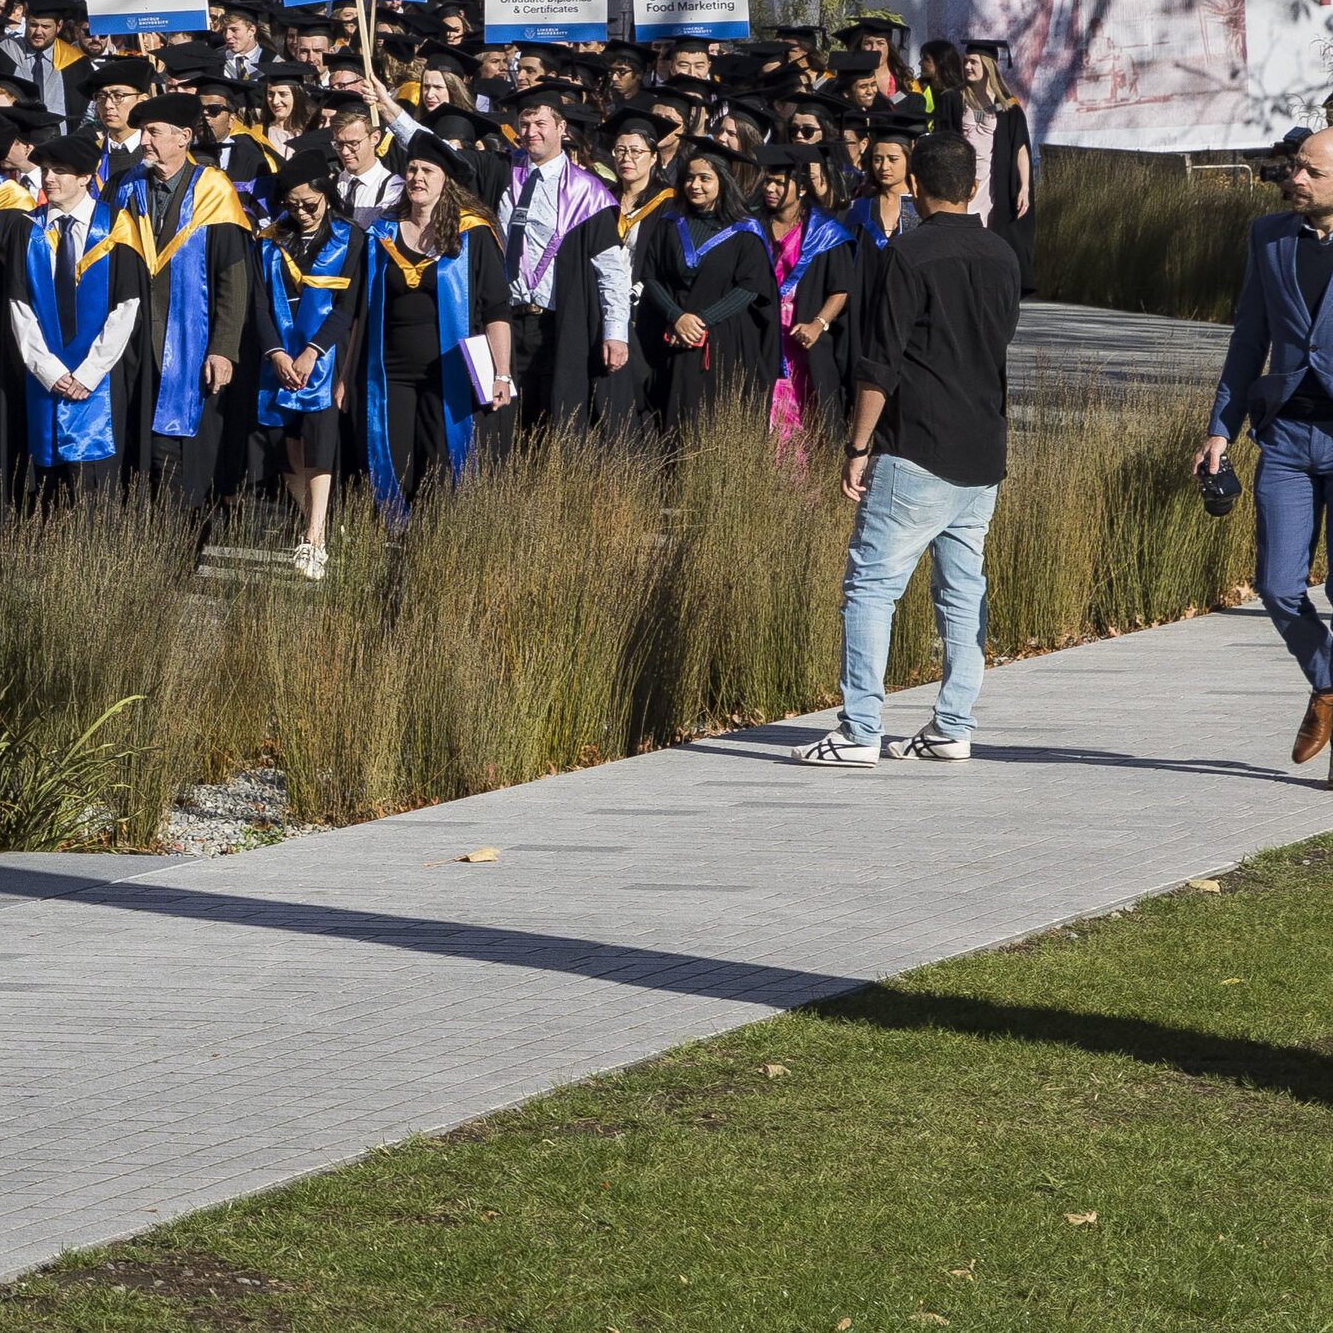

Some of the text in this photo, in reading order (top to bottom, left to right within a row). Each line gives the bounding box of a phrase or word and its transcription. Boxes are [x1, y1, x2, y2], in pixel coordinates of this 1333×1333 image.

[523, 5, 578, 14] Certificates
[646, 0, 735, 12] Food Marketing
